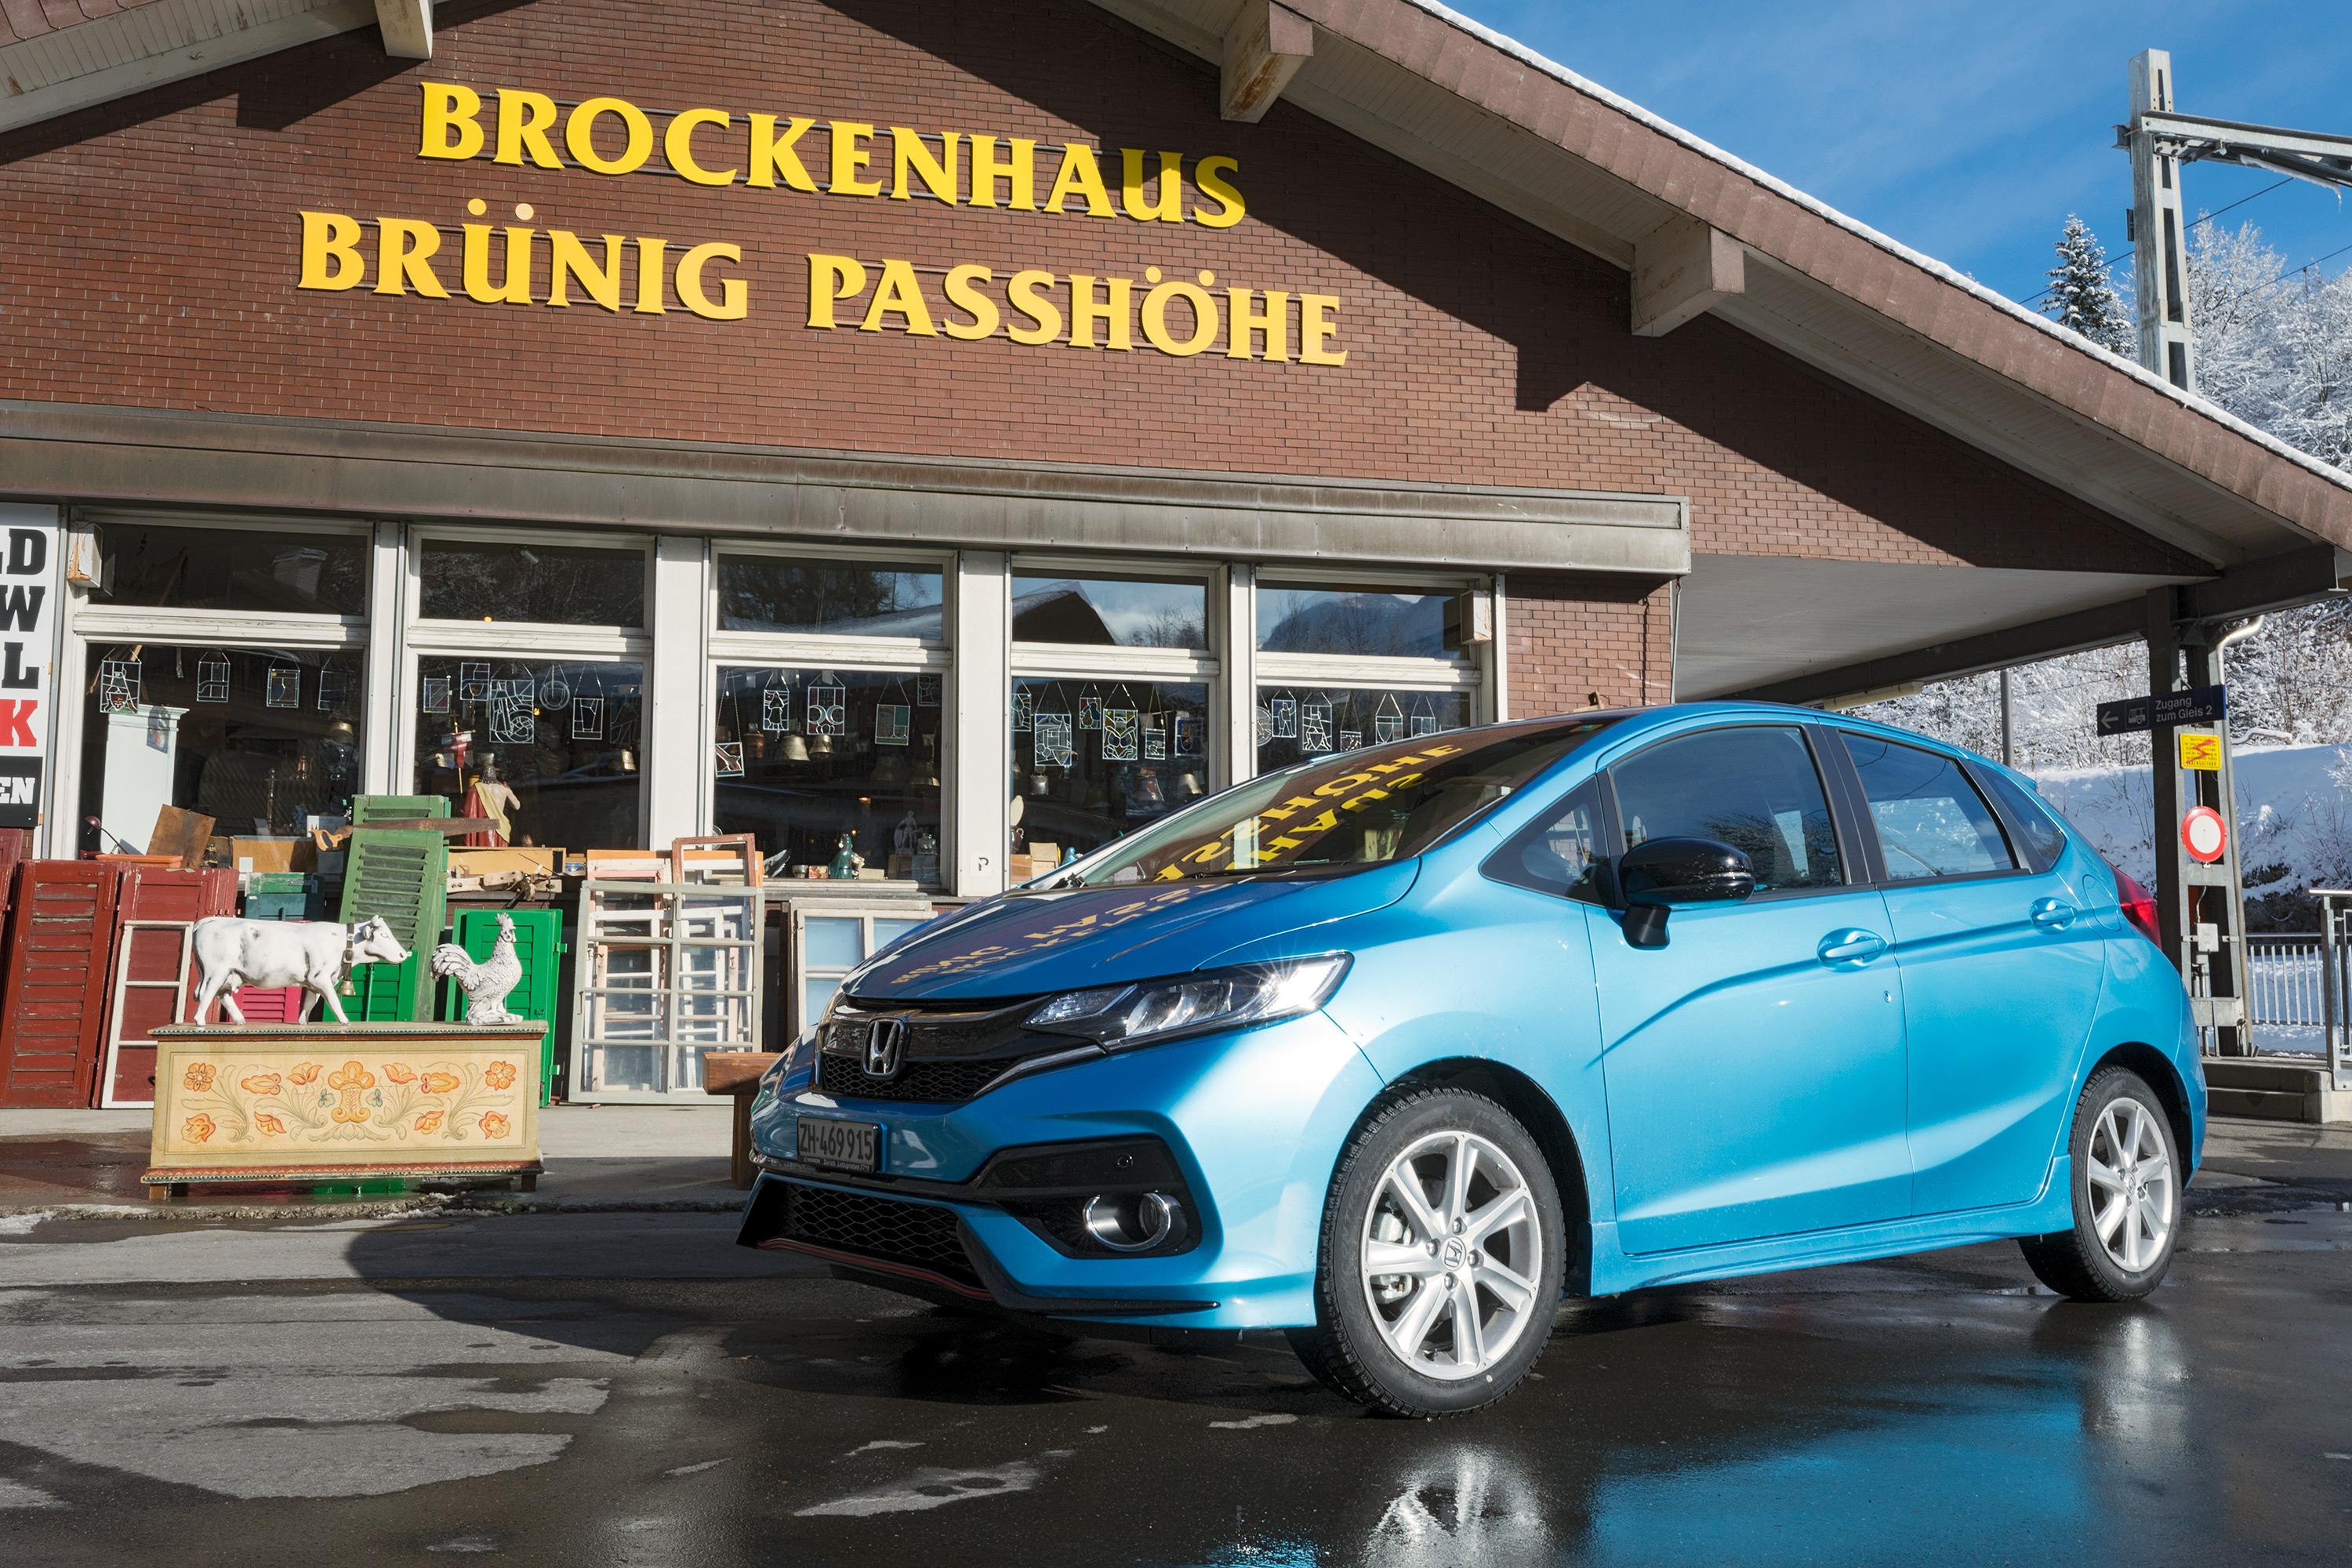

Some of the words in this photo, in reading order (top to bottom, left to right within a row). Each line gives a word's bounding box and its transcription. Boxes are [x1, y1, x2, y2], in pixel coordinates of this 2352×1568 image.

[417, 82, 1246, 229] BROCKENHAUS
[297, 198, 748, 320] BRÜNIG
[806, 253, 1348, 366] PASSHÖHE
[0, 528, 47, 575] D
[2156, 698, 2191, 710] Zugang
[2156, 712, 2176, 722] zum
[2179, 707, 2203, 719] Gleis
[2205, 705, 2212, 716] 2
